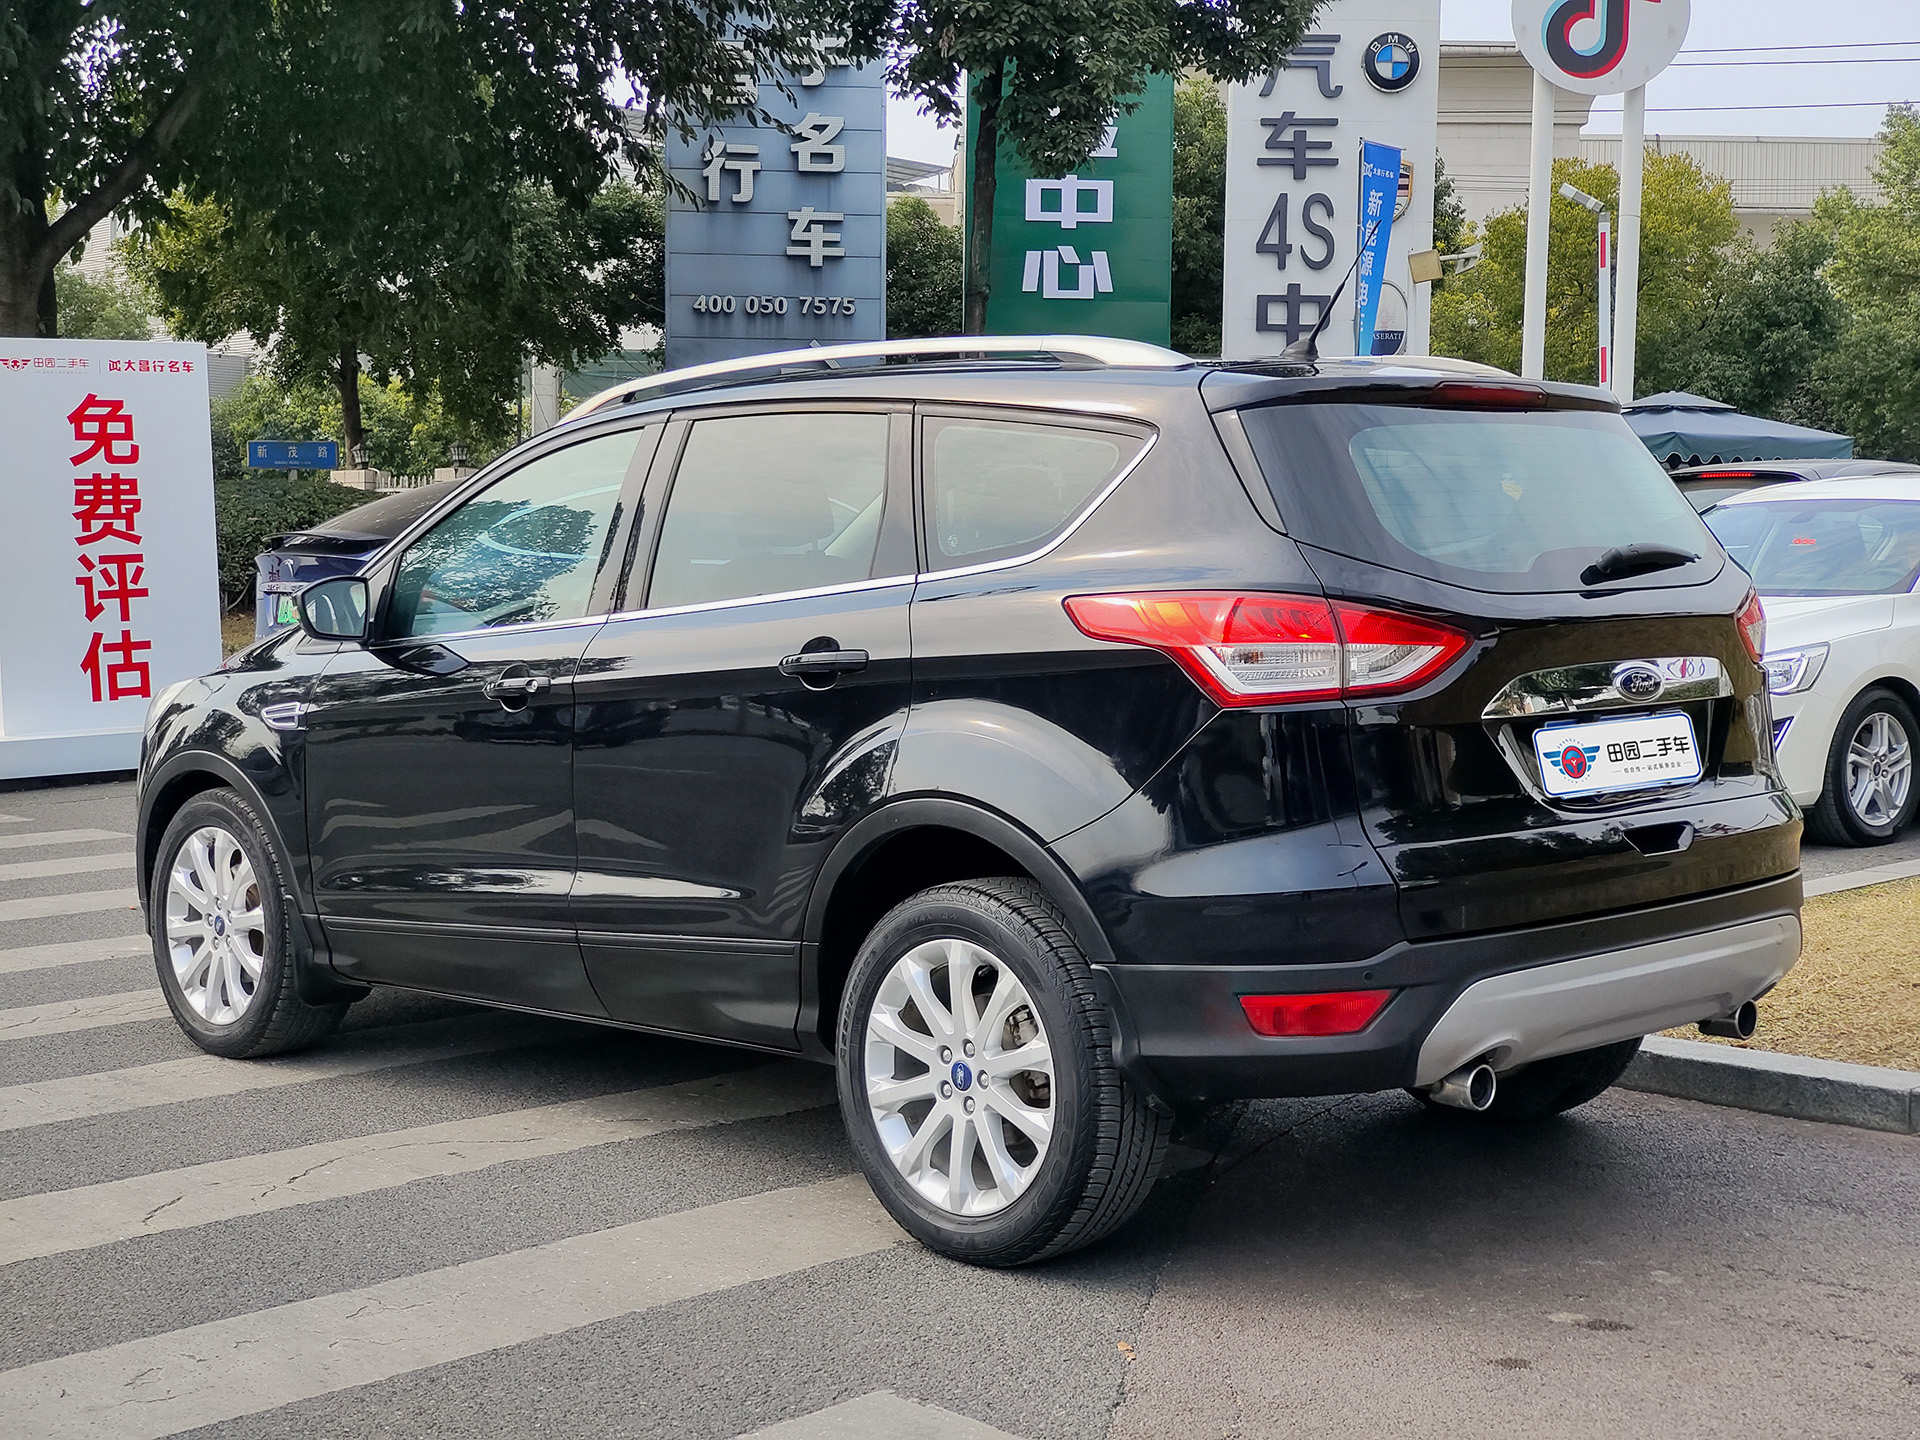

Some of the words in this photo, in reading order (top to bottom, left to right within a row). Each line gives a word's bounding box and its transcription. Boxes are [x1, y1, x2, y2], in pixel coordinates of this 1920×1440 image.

[1370, 34, 1416, 53] BMW
[693, 294, 736, 314] 400
[745, 296, 788, 315] 050
[799, 296, 856, 316] 7575
[33, 357, 90, 369] 田园二手车
[257, 445, 328, 458] 新茂路
[66, 393, 152, 702] 免费评估
[1630, 673, 1656, 692] Ford
[1606, 736, 1691, 763] 田园二手车
